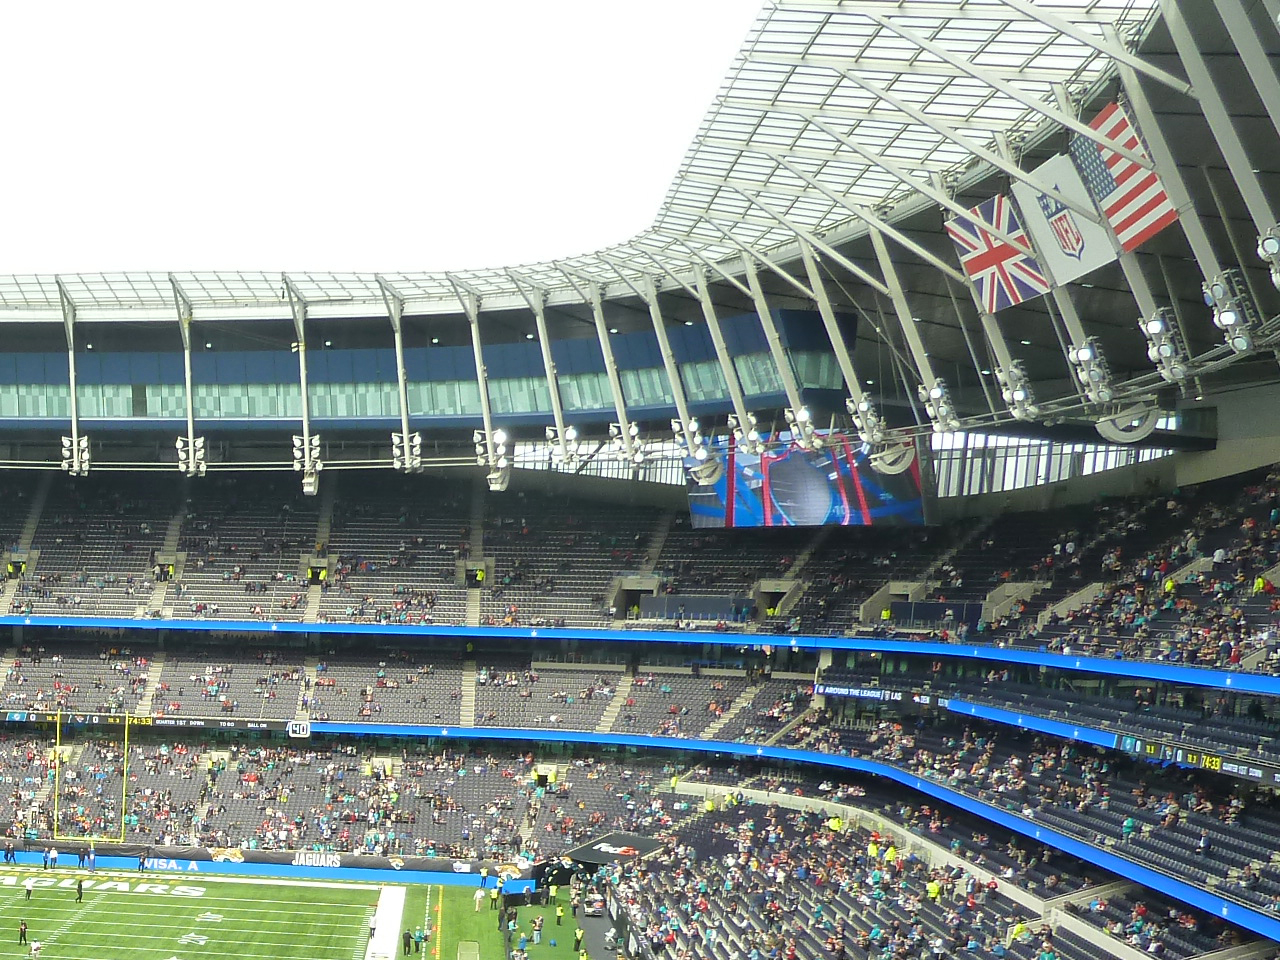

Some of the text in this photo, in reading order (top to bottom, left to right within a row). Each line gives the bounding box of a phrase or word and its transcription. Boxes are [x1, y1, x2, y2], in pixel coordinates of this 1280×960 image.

[1050, 212, 1081, 252] NFL
[825, 687, 849, 695] AROUND
[860, 690, 881, 698] LEAGUE
[891, 692, 902, 700] LAS
[29, 713, 36, 721] 0
[92, 715, 99, 723] 0
[128, 716, 151, 725] 74:33
[291, 724, 307, 735] 40
[1176, 750, 1182, 762] 0
[1202, 755, 1220, 771] 74:33
[187, 860, 198, 871] A
[291, 852, 341, 868] JAGUARS
